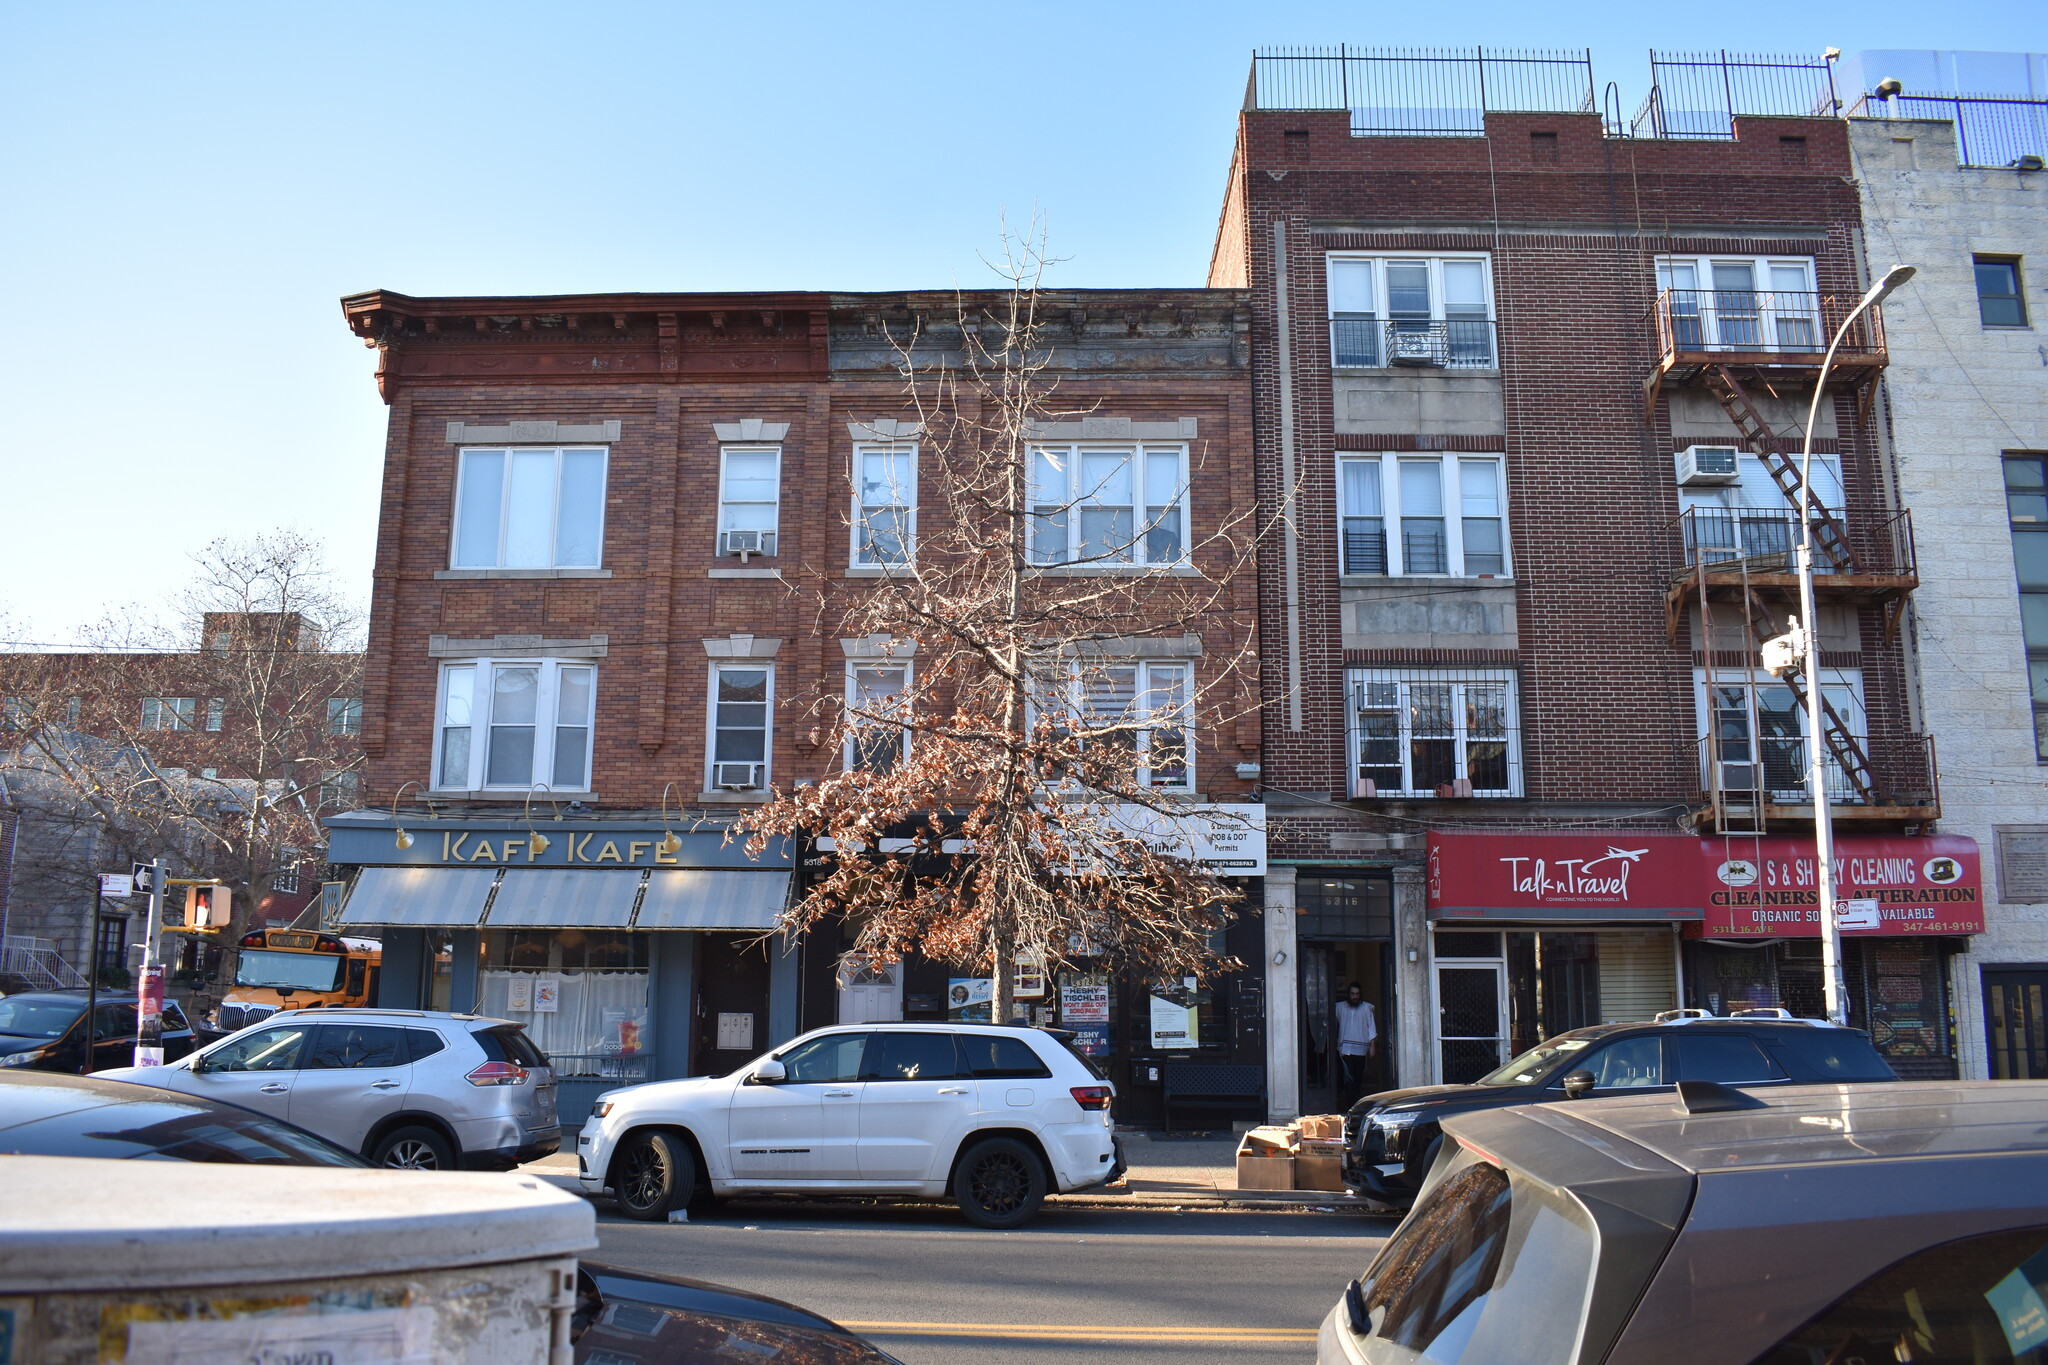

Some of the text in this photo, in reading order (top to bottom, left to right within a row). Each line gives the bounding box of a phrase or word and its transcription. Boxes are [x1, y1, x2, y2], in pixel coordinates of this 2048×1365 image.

[1211, 833, 1248, 841] DOB & DOT
[567, 832, 678, 864] KAFE
[1214, 844, 1239, 852] Permits
[803, 858, 822, 866] 5318
[1767, 859, 1776, 886] S
[1782, 863, 1791, 886] &
[1851, 858, 1915, 885] CLEANING
[1499, 856, 1629, 901] Talk n Travel
[1325, 896, 1358, 906] 5316
[1710, 889, 1818, 906] CLEANERS
[1752, 910, 1801, 923] ORGANIC
[1740, 925, 1751, 933] 16
[1754, 925, 1777, 933] AVE.
[1903, 921, 1979, 932] 347-461-9191
[1063, 994, 1106, 1002] TISCHLER
